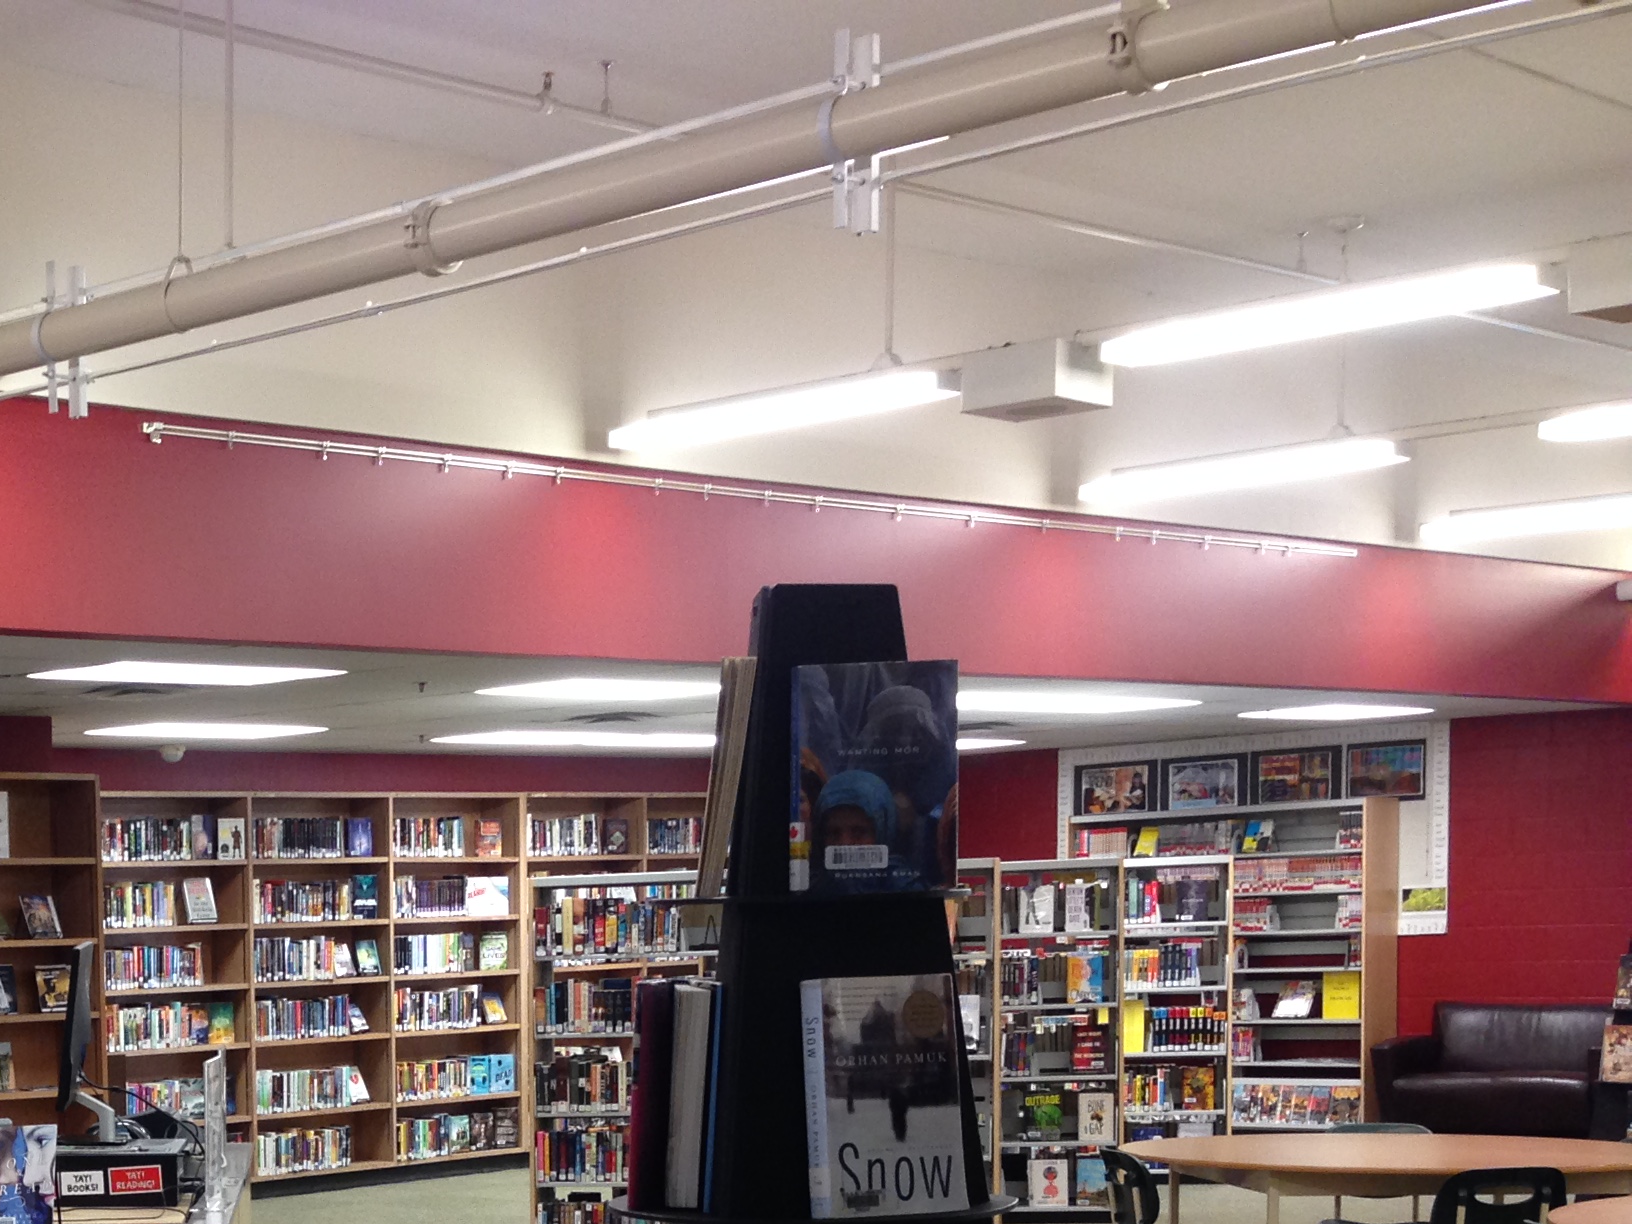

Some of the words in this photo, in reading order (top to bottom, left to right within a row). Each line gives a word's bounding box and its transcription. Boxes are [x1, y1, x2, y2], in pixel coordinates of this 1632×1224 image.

[835, 1053, 889, 1067] ORHAN
[895, 1052, 947, 1065] PAMUK
[67, 1183, 99, 1193] BOOKS!
